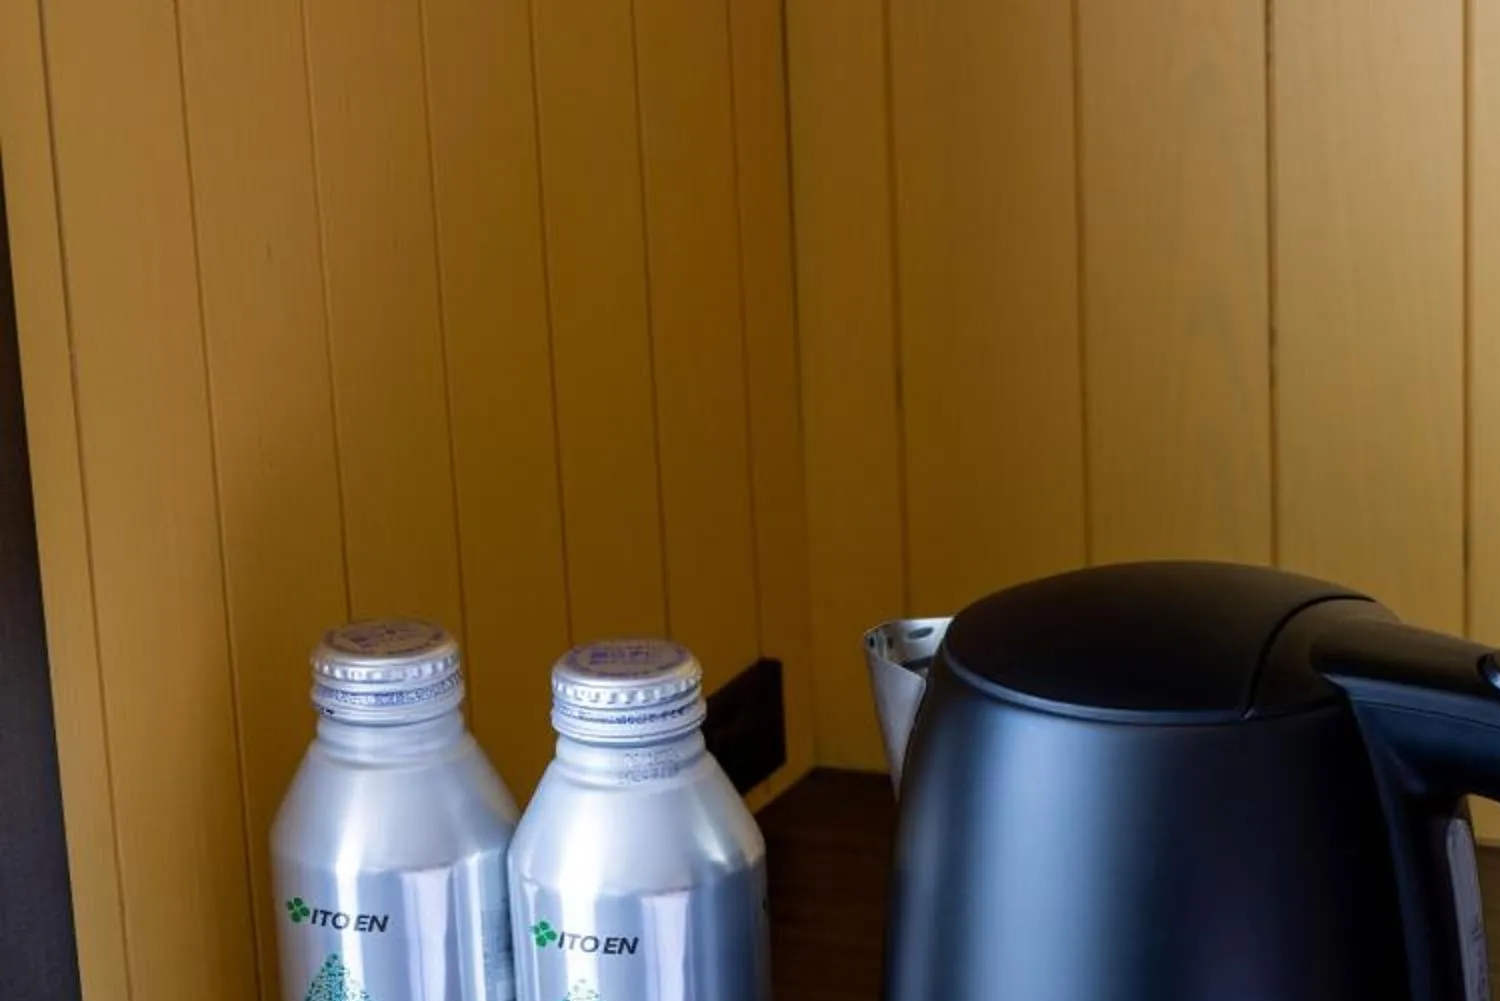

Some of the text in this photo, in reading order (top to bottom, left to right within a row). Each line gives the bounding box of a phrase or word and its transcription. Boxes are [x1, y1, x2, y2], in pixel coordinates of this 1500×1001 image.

[311, 908, 389, 933] ITO EN
[558, 931, 639, 955] ITO EN
